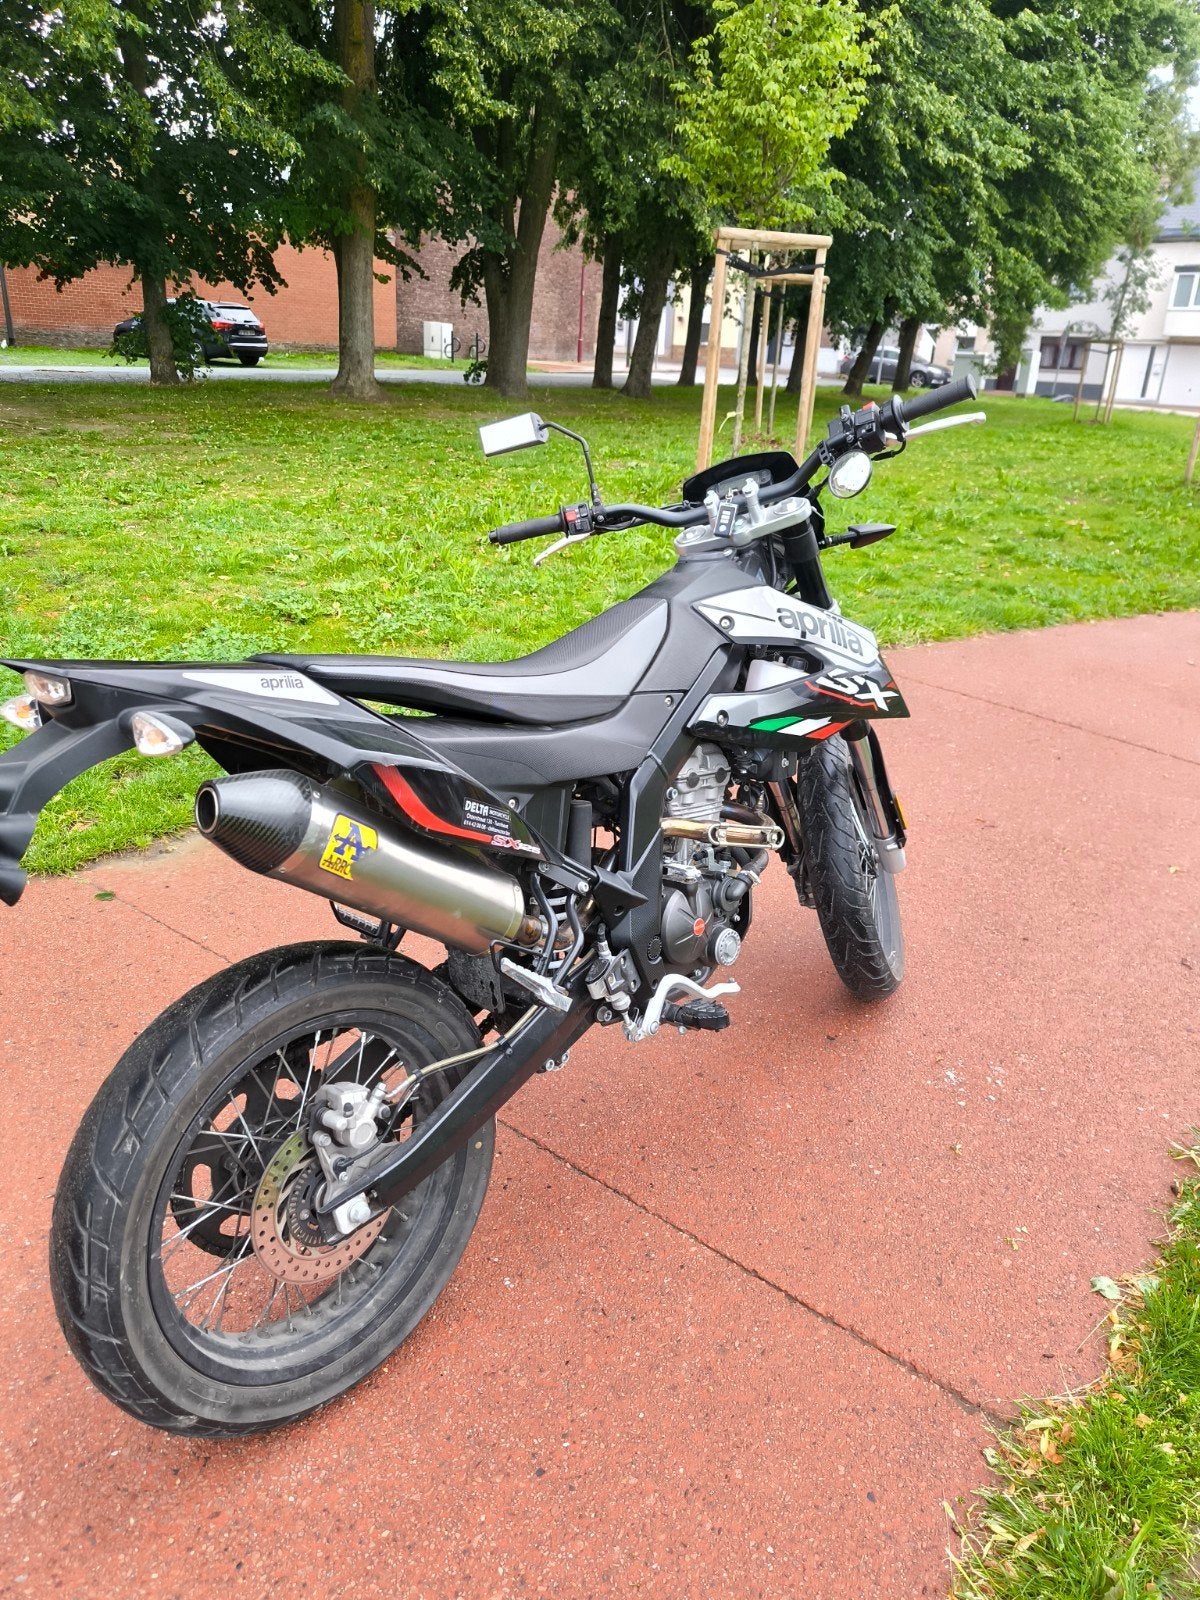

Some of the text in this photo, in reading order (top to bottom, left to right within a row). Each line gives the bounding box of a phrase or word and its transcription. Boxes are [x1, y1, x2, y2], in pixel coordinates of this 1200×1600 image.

[776, 607, 864, 656] aprilia
[260, 675, 304, 691] aprilia
[815, 667, 899, 711] SX
[465, 800, 489, 816] DELTA
